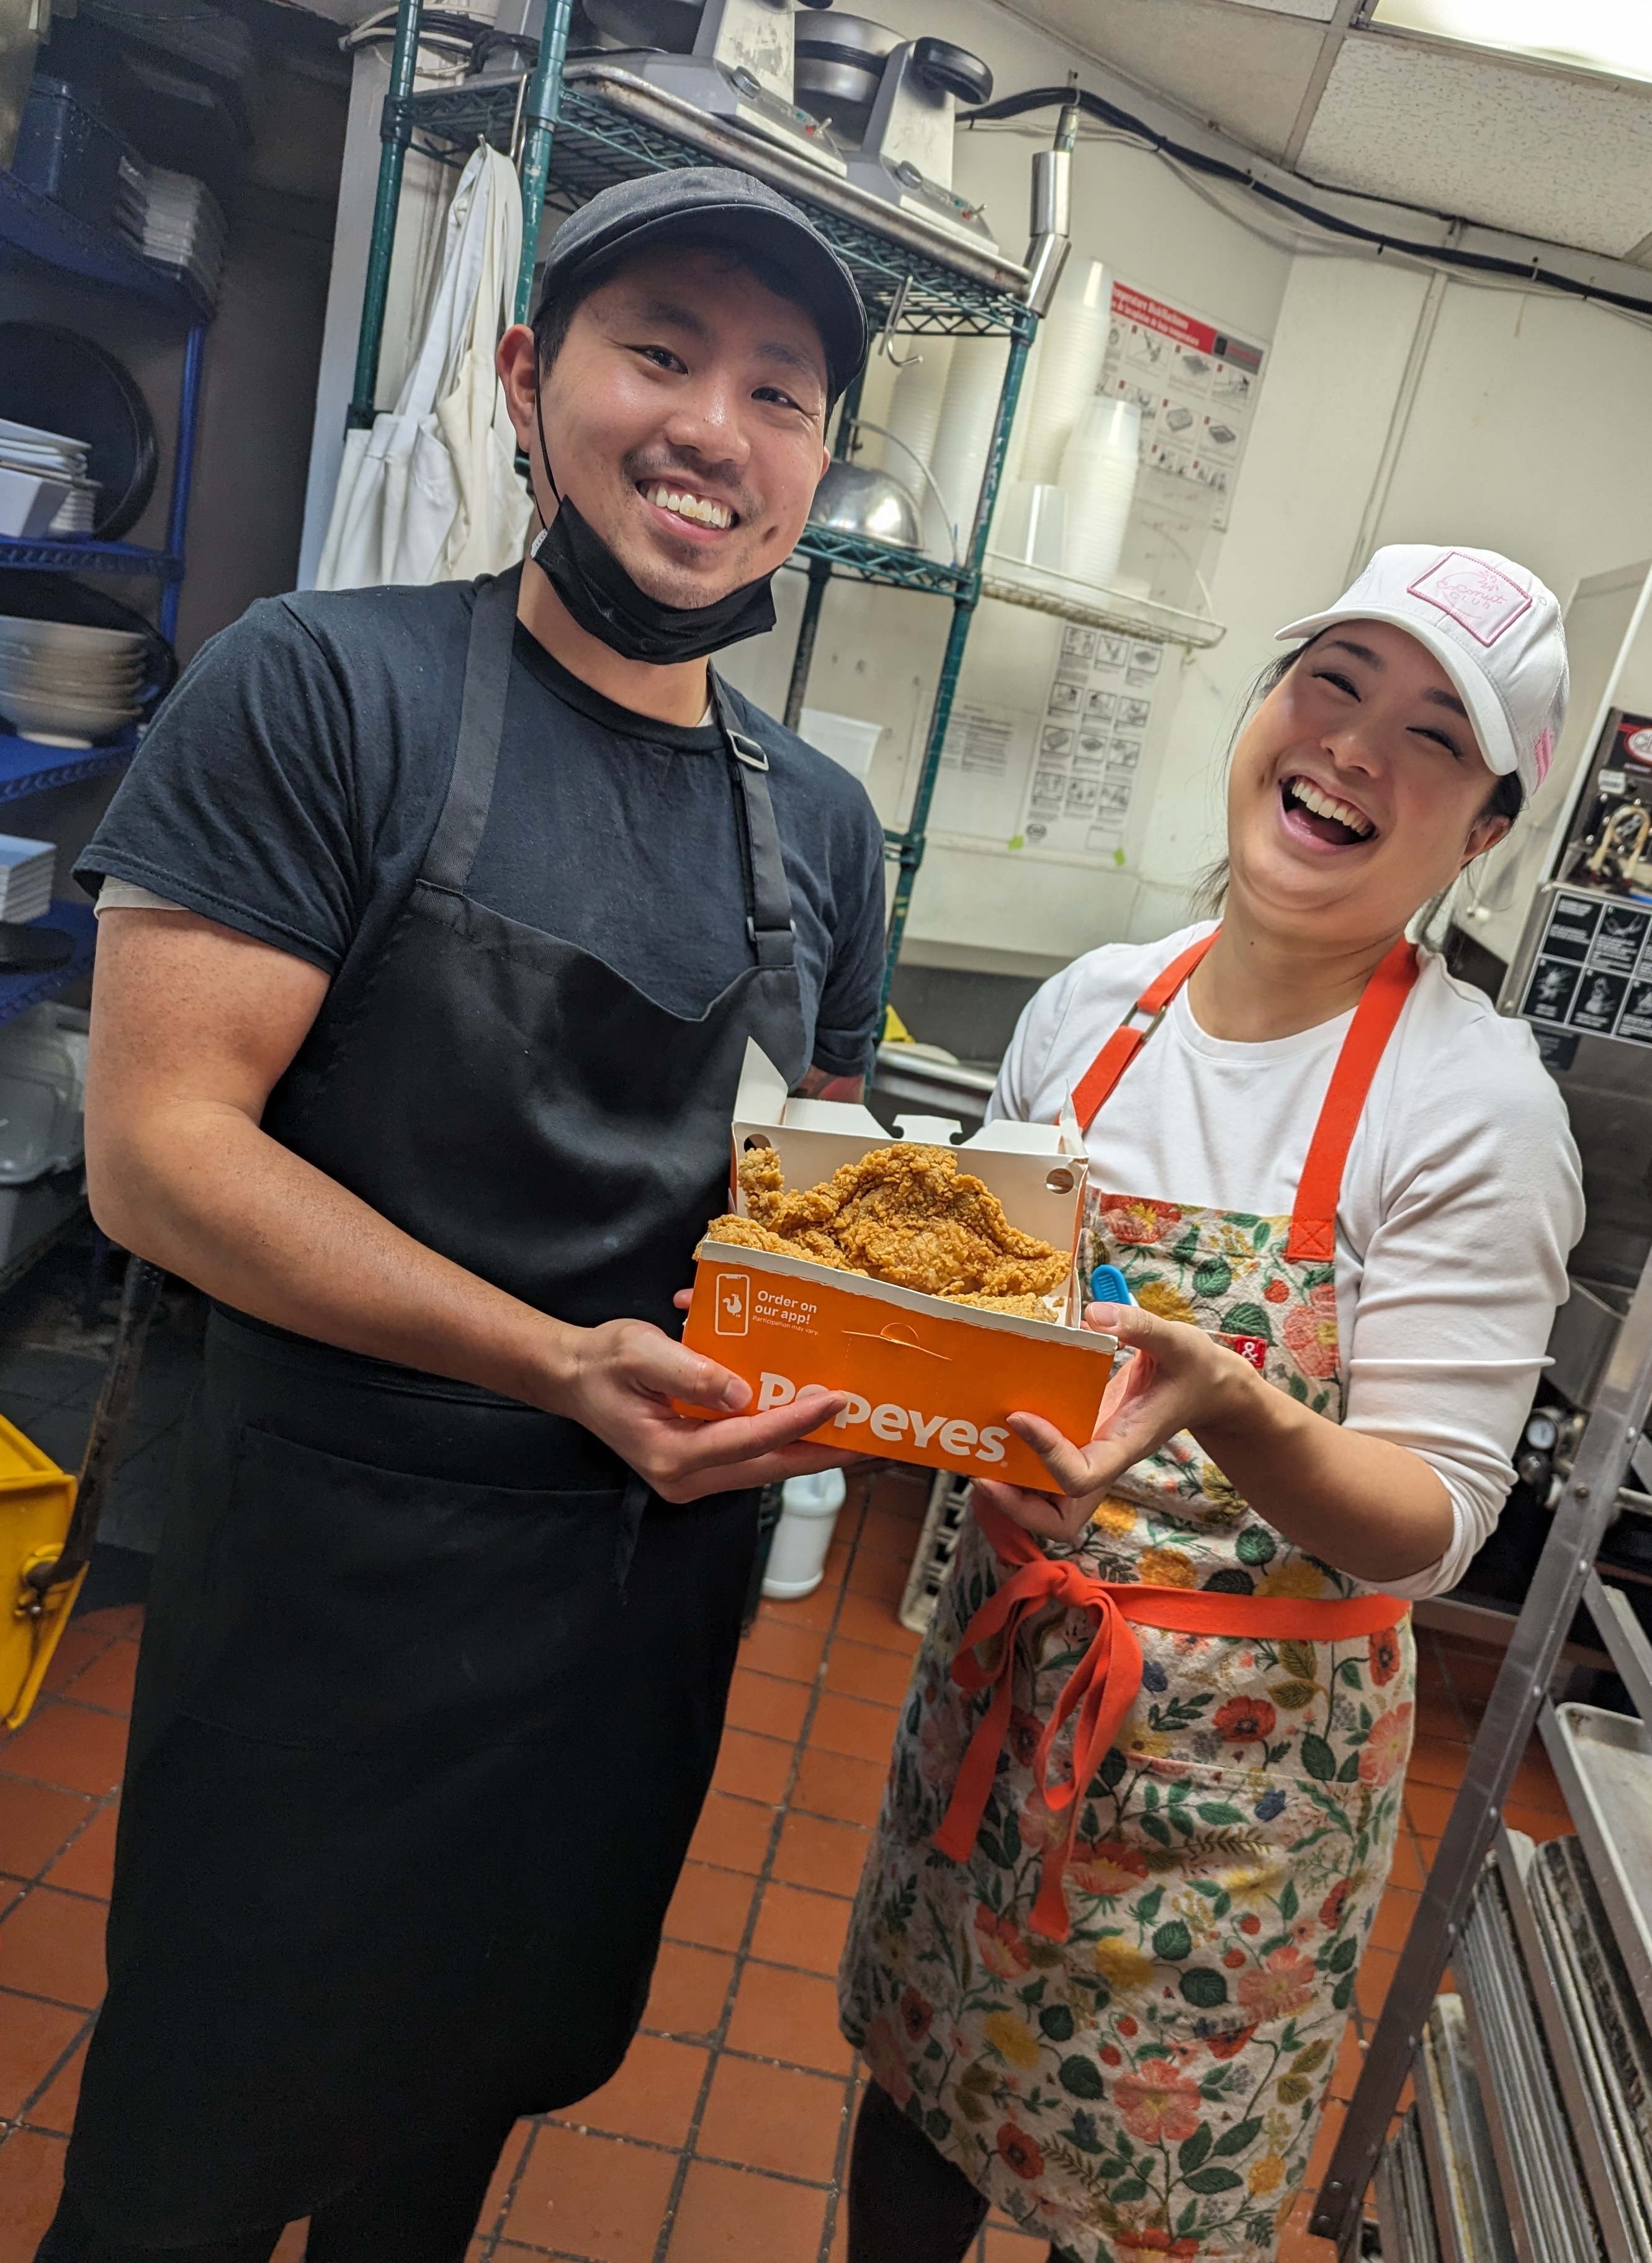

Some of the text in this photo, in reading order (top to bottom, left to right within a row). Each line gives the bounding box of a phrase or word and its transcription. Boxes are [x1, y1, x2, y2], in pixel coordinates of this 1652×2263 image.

[1450, 592, 1491, 610] CLUB
[758, 1290, 817, 1313] Order on
[752, 1315, 791, 1329] Participation
[791, 1325, 804, 1333] may
[755, 1305, 810, 1325] our app!
[1242, 1341, 1259, 1363] &
